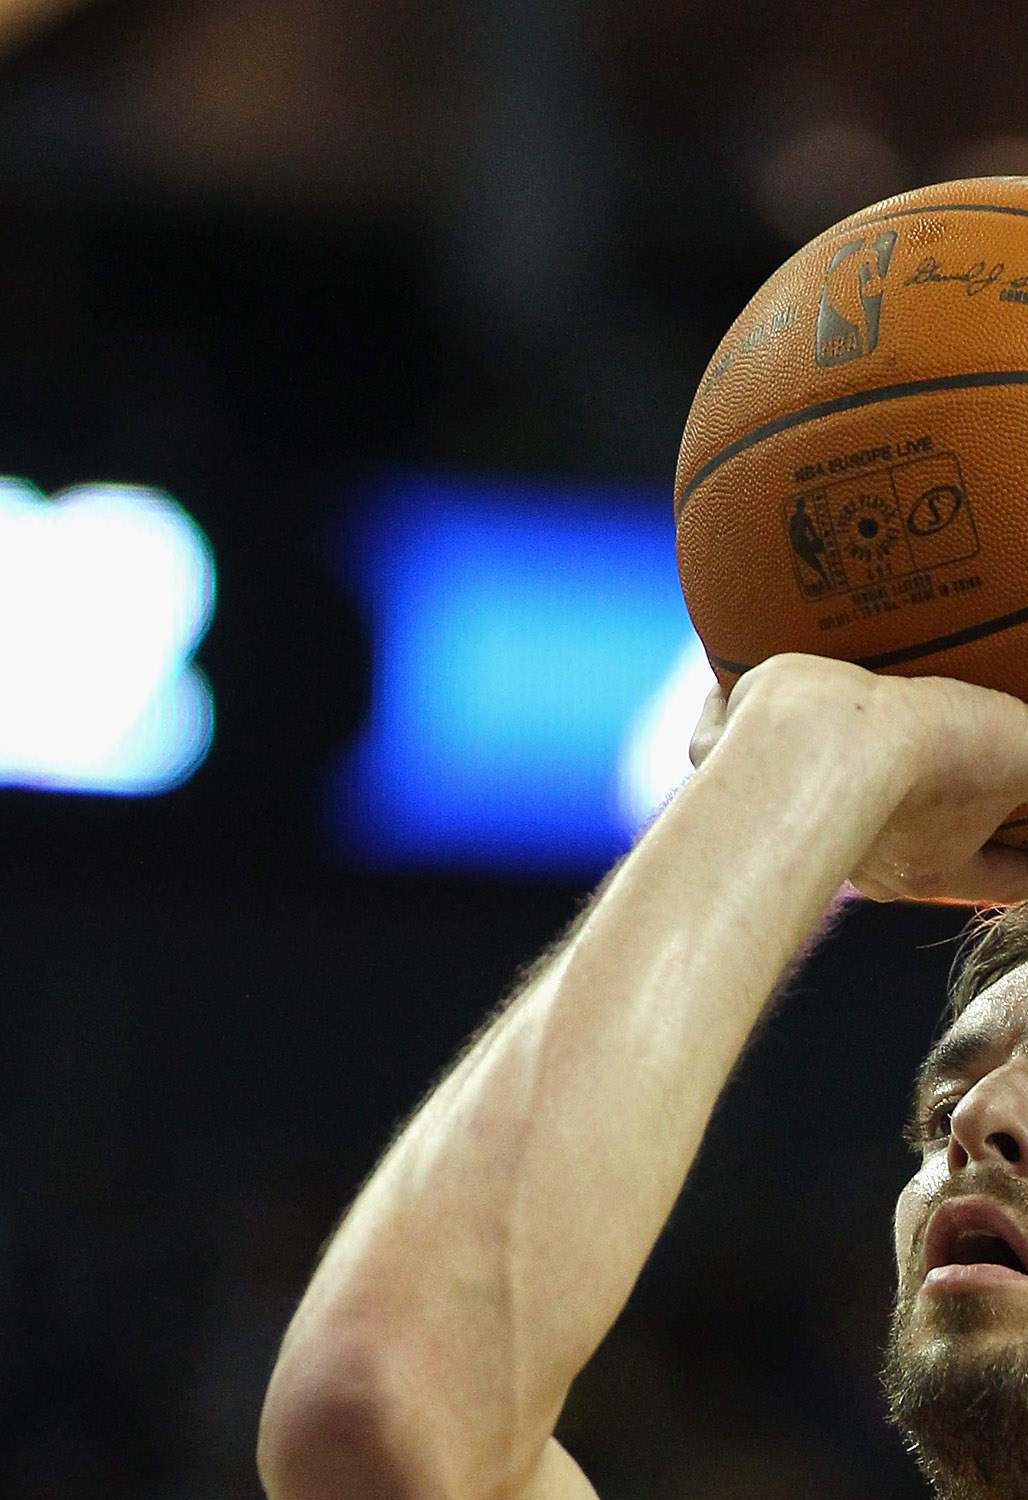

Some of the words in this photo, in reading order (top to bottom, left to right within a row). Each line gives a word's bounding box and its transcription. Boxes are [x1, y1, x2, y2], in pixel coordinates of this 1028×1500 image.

[795, 463, 826, 483] NBA
[828, 444, 893, 471] EUROPE
[896, 435, 934, 458] LIVE
